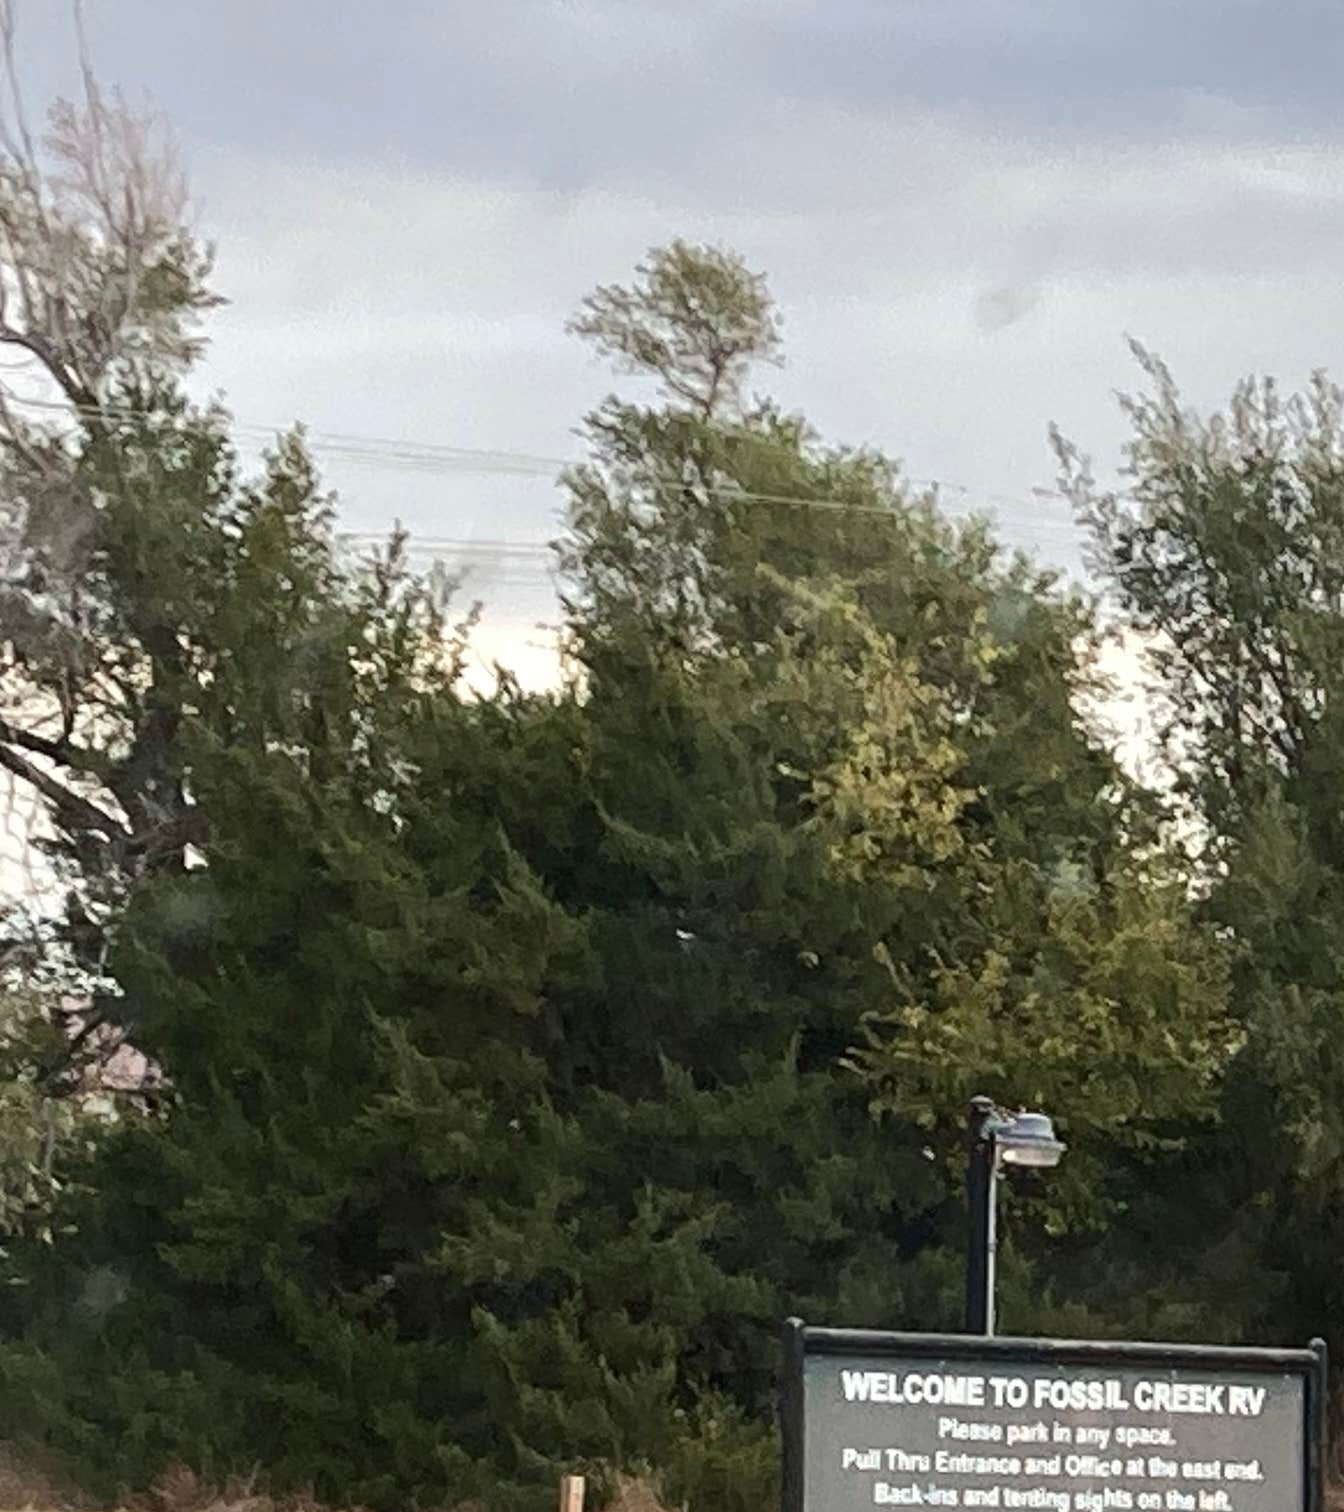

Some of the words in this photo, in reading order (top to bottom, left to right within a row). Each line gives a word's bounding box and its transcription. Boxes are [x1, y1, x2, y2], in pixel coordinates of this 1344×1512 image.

[842, 1370, 985, 1405] WELCOME
[989, 1376, 1028, 1408] TO
[1033, 1378, 1129, 1411] FOSSIL
[1134, 1381, 1225, 1414] CREEK
[1229, 1385, 1266, 1416] RV
[938, 1417, 1002, 1441] Please
[1006, 1421, 1049, 1446] park
[1052, 1420, 1072, 1443] in
[1075, 1426, 1111, 1450] any
[1115, 1426, 1176, 1448] space.
[842, 1448, 881, 1471] Pull
[885, 1449, 930, 1472] Thru
[934, 1450, 1021, 1474] Entrance
[1025, 1455, 1061, 1476] and
[1065, 1455, 1123, 1477] Office
[1126, 1457, 1145, 1477] at
[1148, 1456, 1177, 1478] the
[1182, 1459, 1221, 1480] east
[874, 1482, 958, 1506] Back-ins
[963, 1487, 999, 1507] and
[1137, 1492, 1162, 1510] on
[1165, 1488, 1196, 1511] the
[1199, 1489, 1234, 1512] left.
